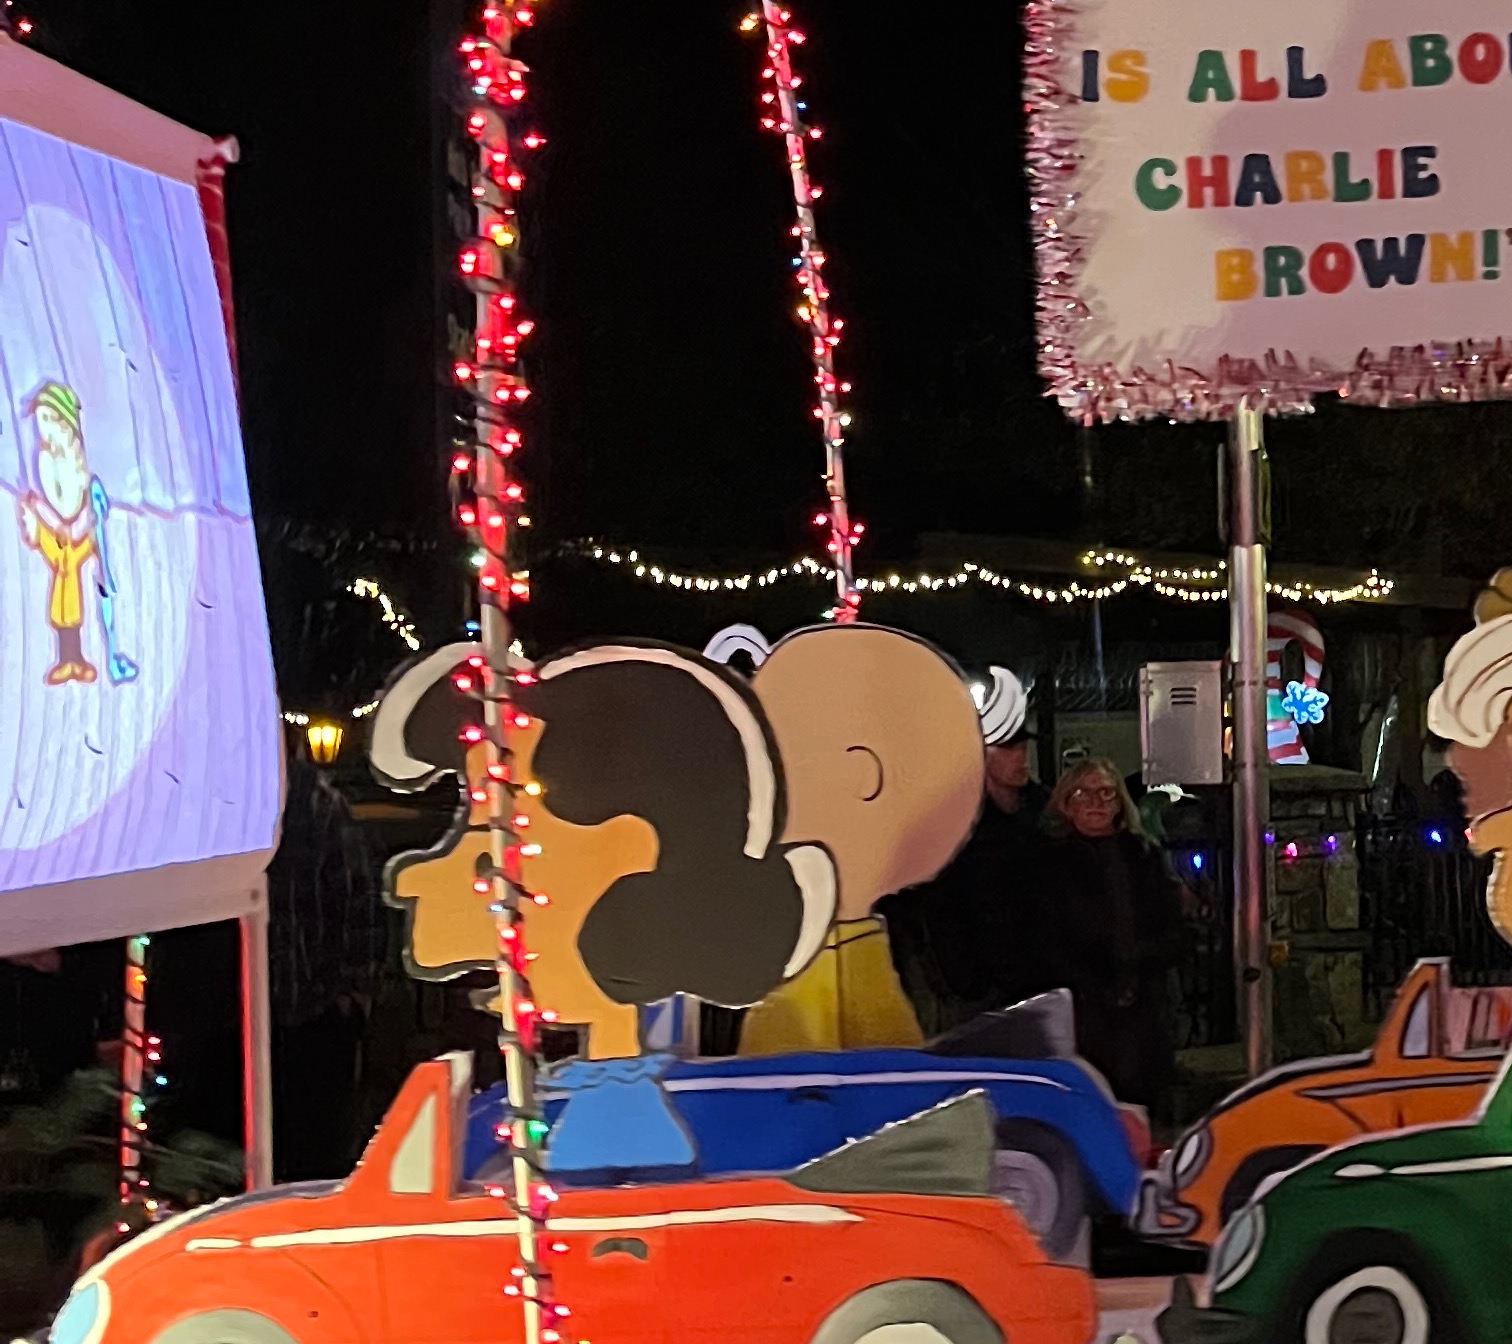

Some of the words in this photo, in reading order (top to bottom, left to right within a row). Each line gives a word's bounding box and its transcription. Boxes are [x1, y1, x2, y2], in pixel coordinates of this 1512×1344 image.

[1082, 49, 1150, 103] IS
[1188, 45, 1328, 103] ALL
[1135, 146, 1441, 212] CHARLIE
